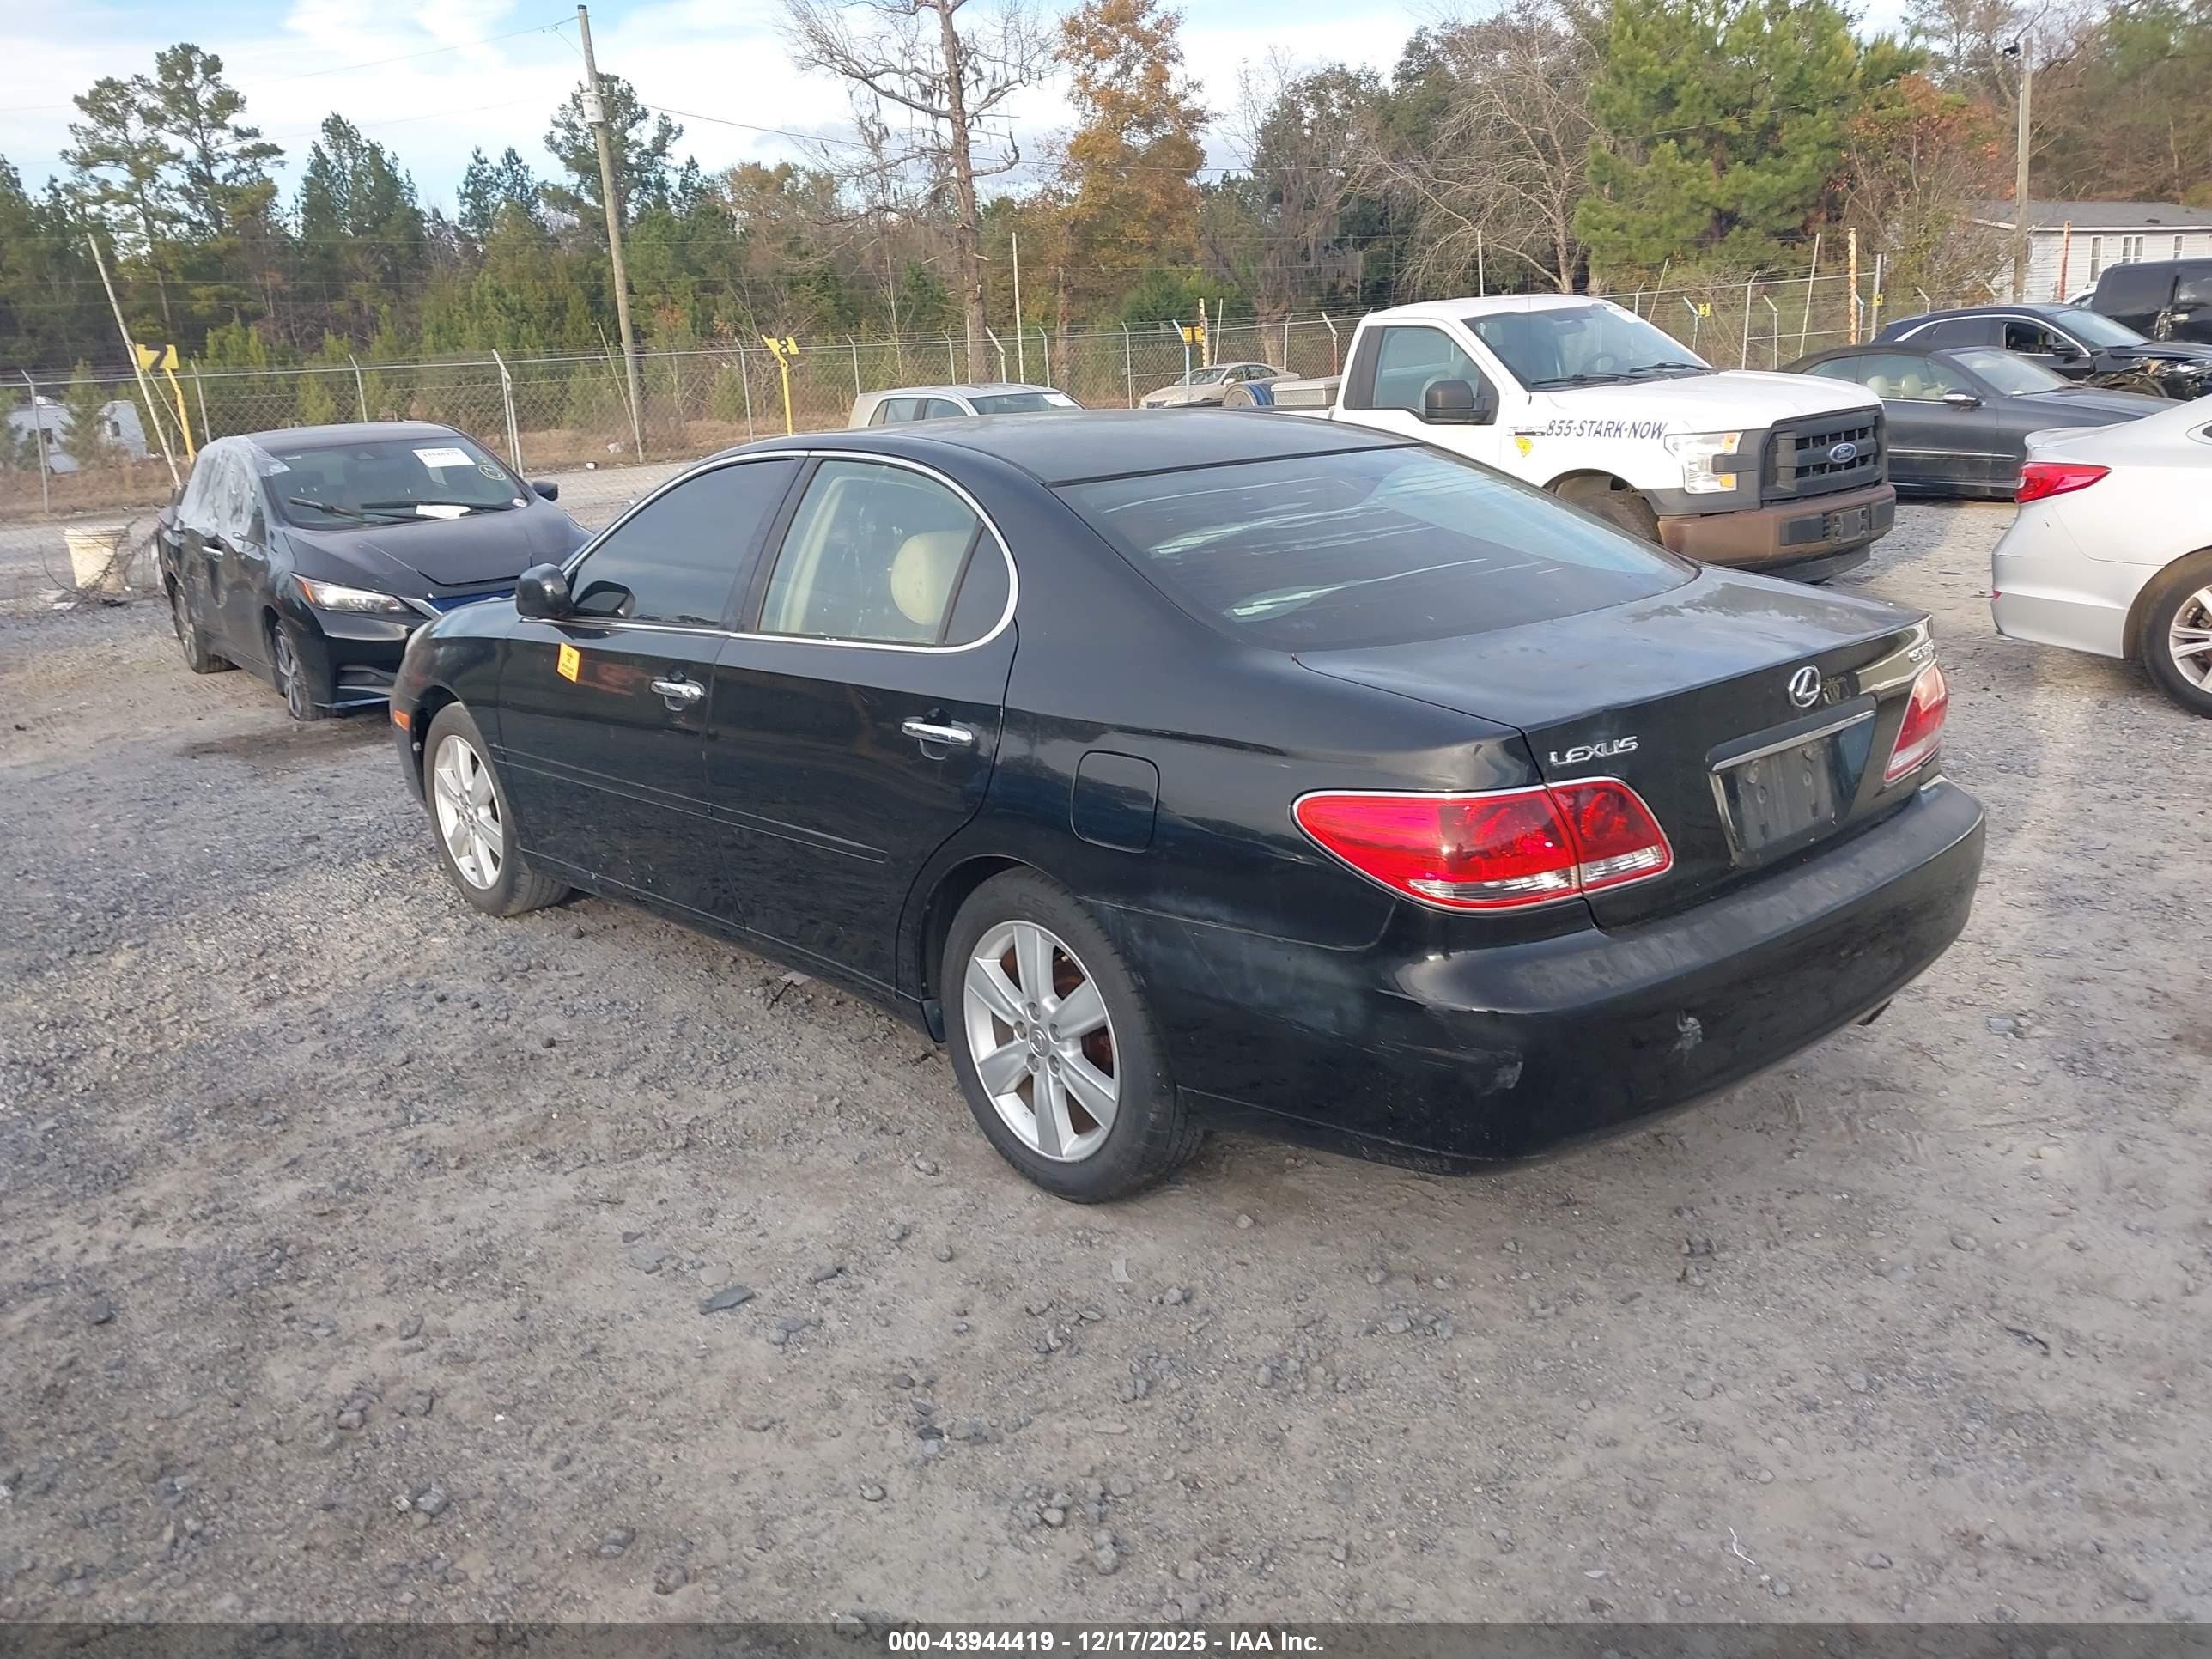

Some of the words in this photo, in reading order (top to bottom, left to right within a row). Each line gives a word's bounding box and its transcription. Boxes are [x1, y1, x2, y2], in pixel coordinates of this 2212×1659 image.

[144, 343, 169, 370] 7
[777, 337, 791, 354] 8
[1547, 419, 1668, 441] 855-STARK-NOW
[1549, 736, 1639, 765] LEXUS
